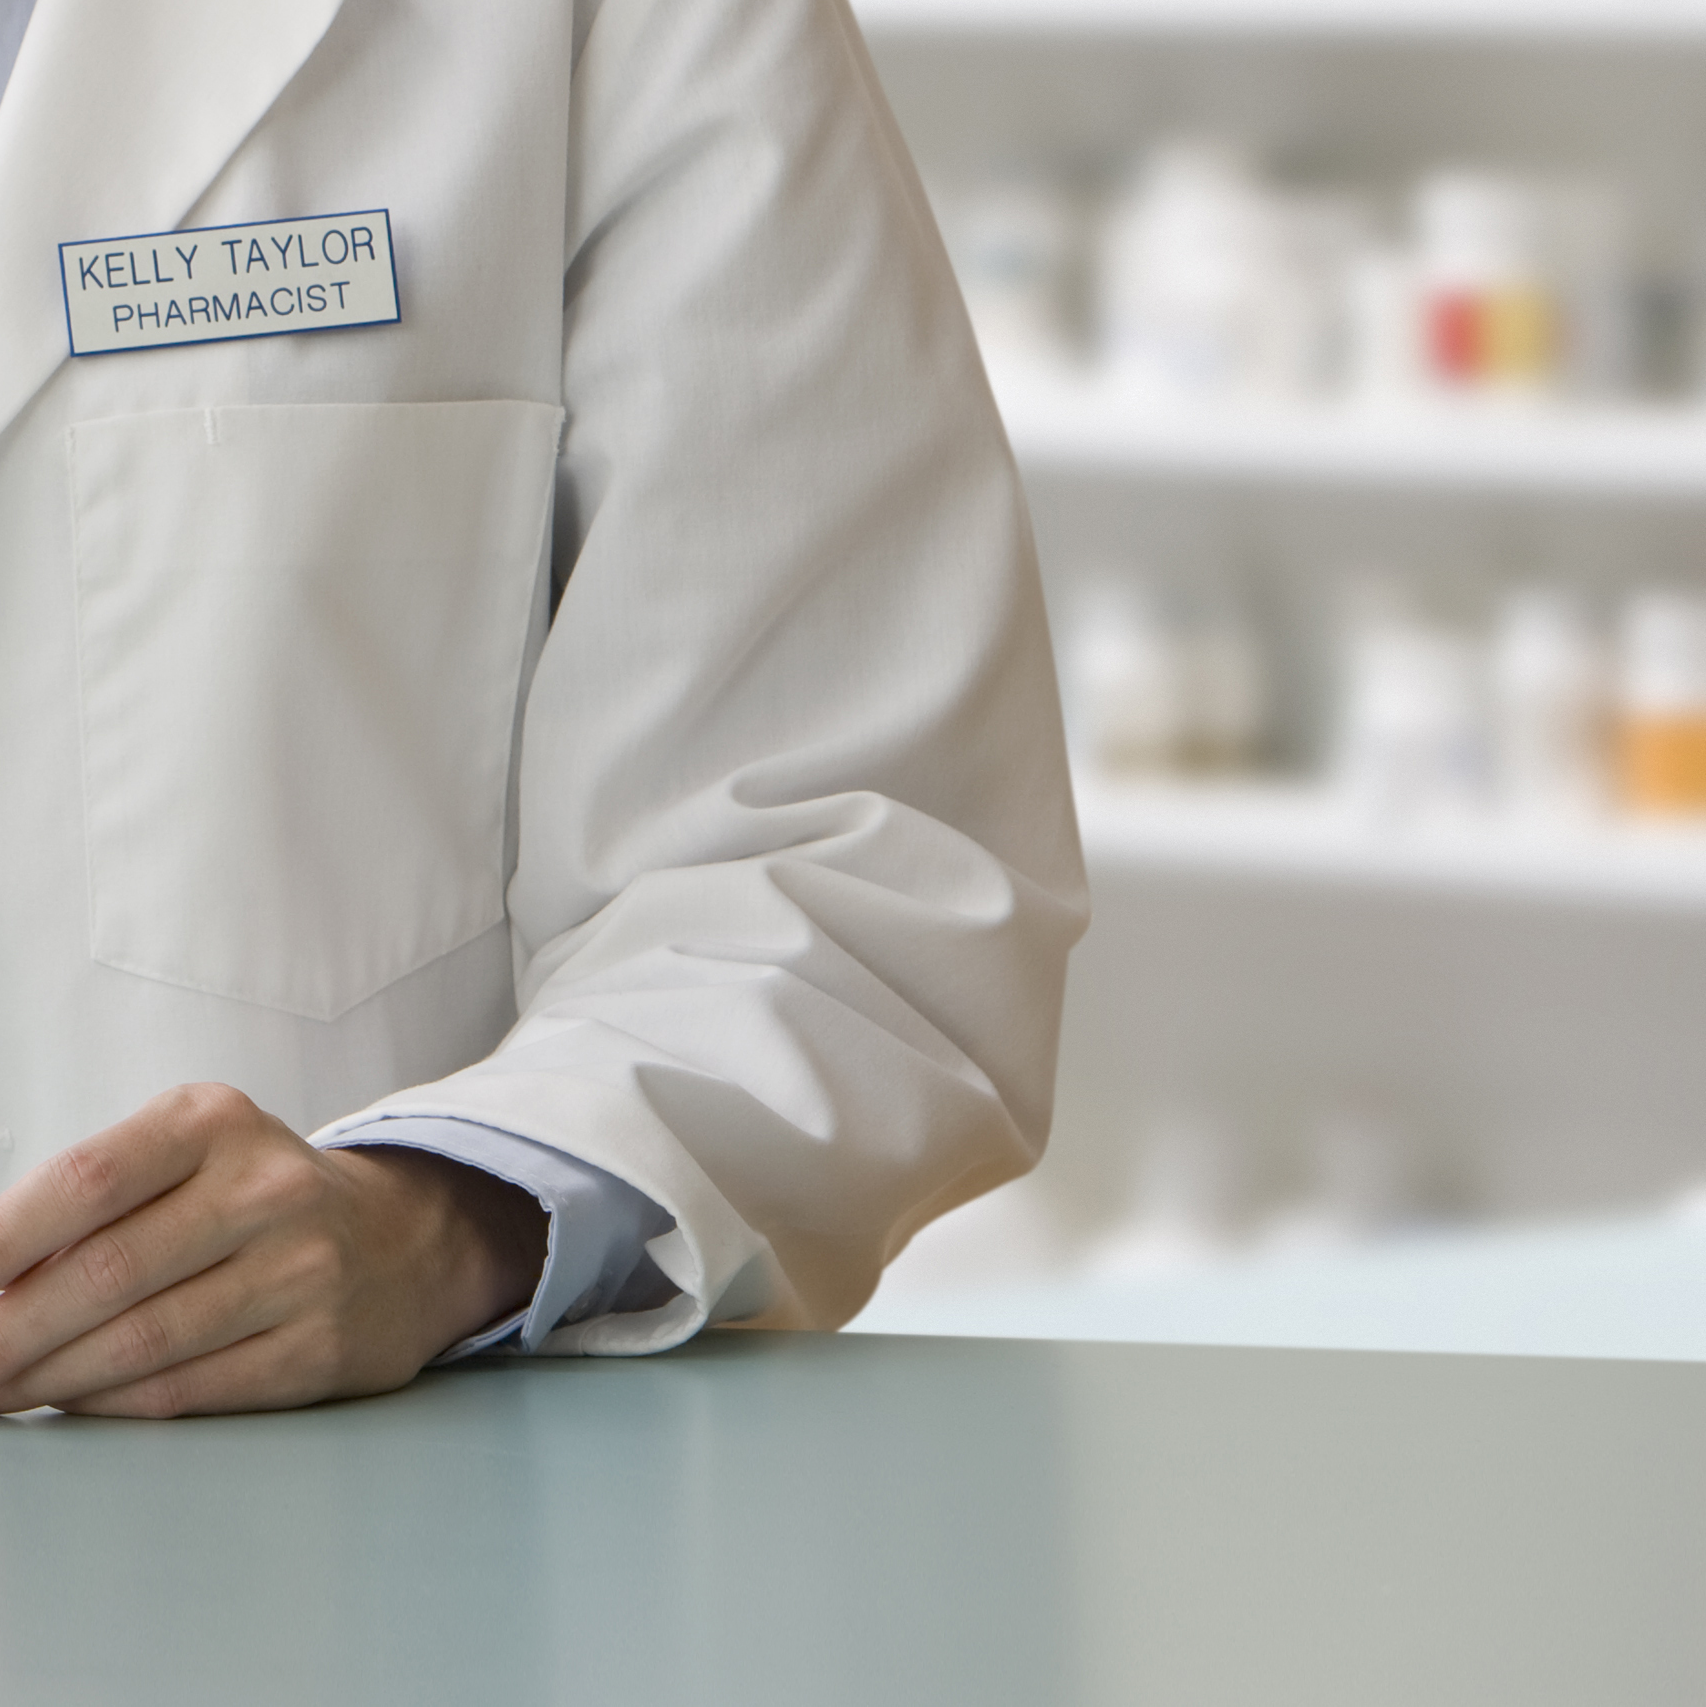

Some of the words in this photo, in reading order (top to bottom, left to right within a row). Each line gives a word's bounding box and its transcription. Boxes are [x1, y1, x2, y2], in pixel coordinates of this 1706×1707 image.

[78, 243, 199, 290] KELLY
[220, 225, 376, 275] TAYLOR
[112, 280, 351, 333] PHARMACIST
